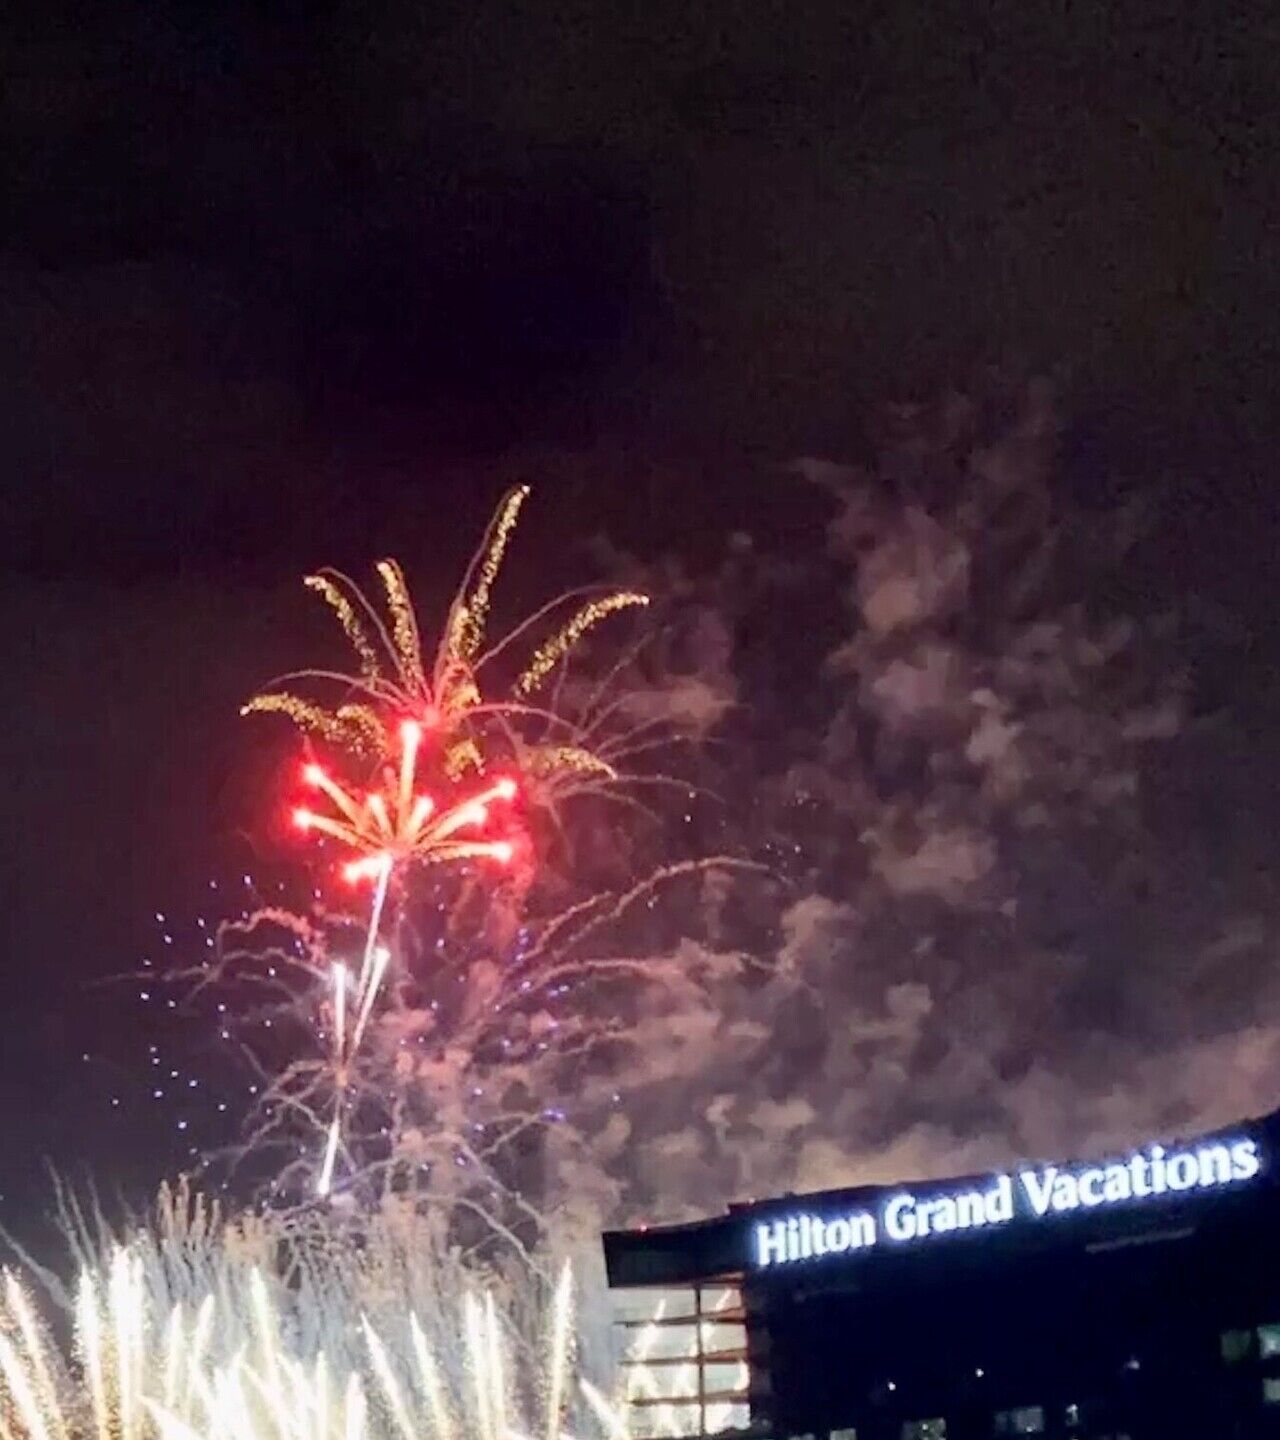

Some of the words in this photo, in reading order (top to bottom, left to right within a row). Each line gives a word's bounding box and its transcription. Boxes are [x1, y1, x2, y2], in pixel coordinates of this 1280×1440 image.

[756, 1212, 877, 1266] Hilton
[884, 1174, 1013, 1240] Grand
[1020, 1137, 1260, 1216] Vacations
